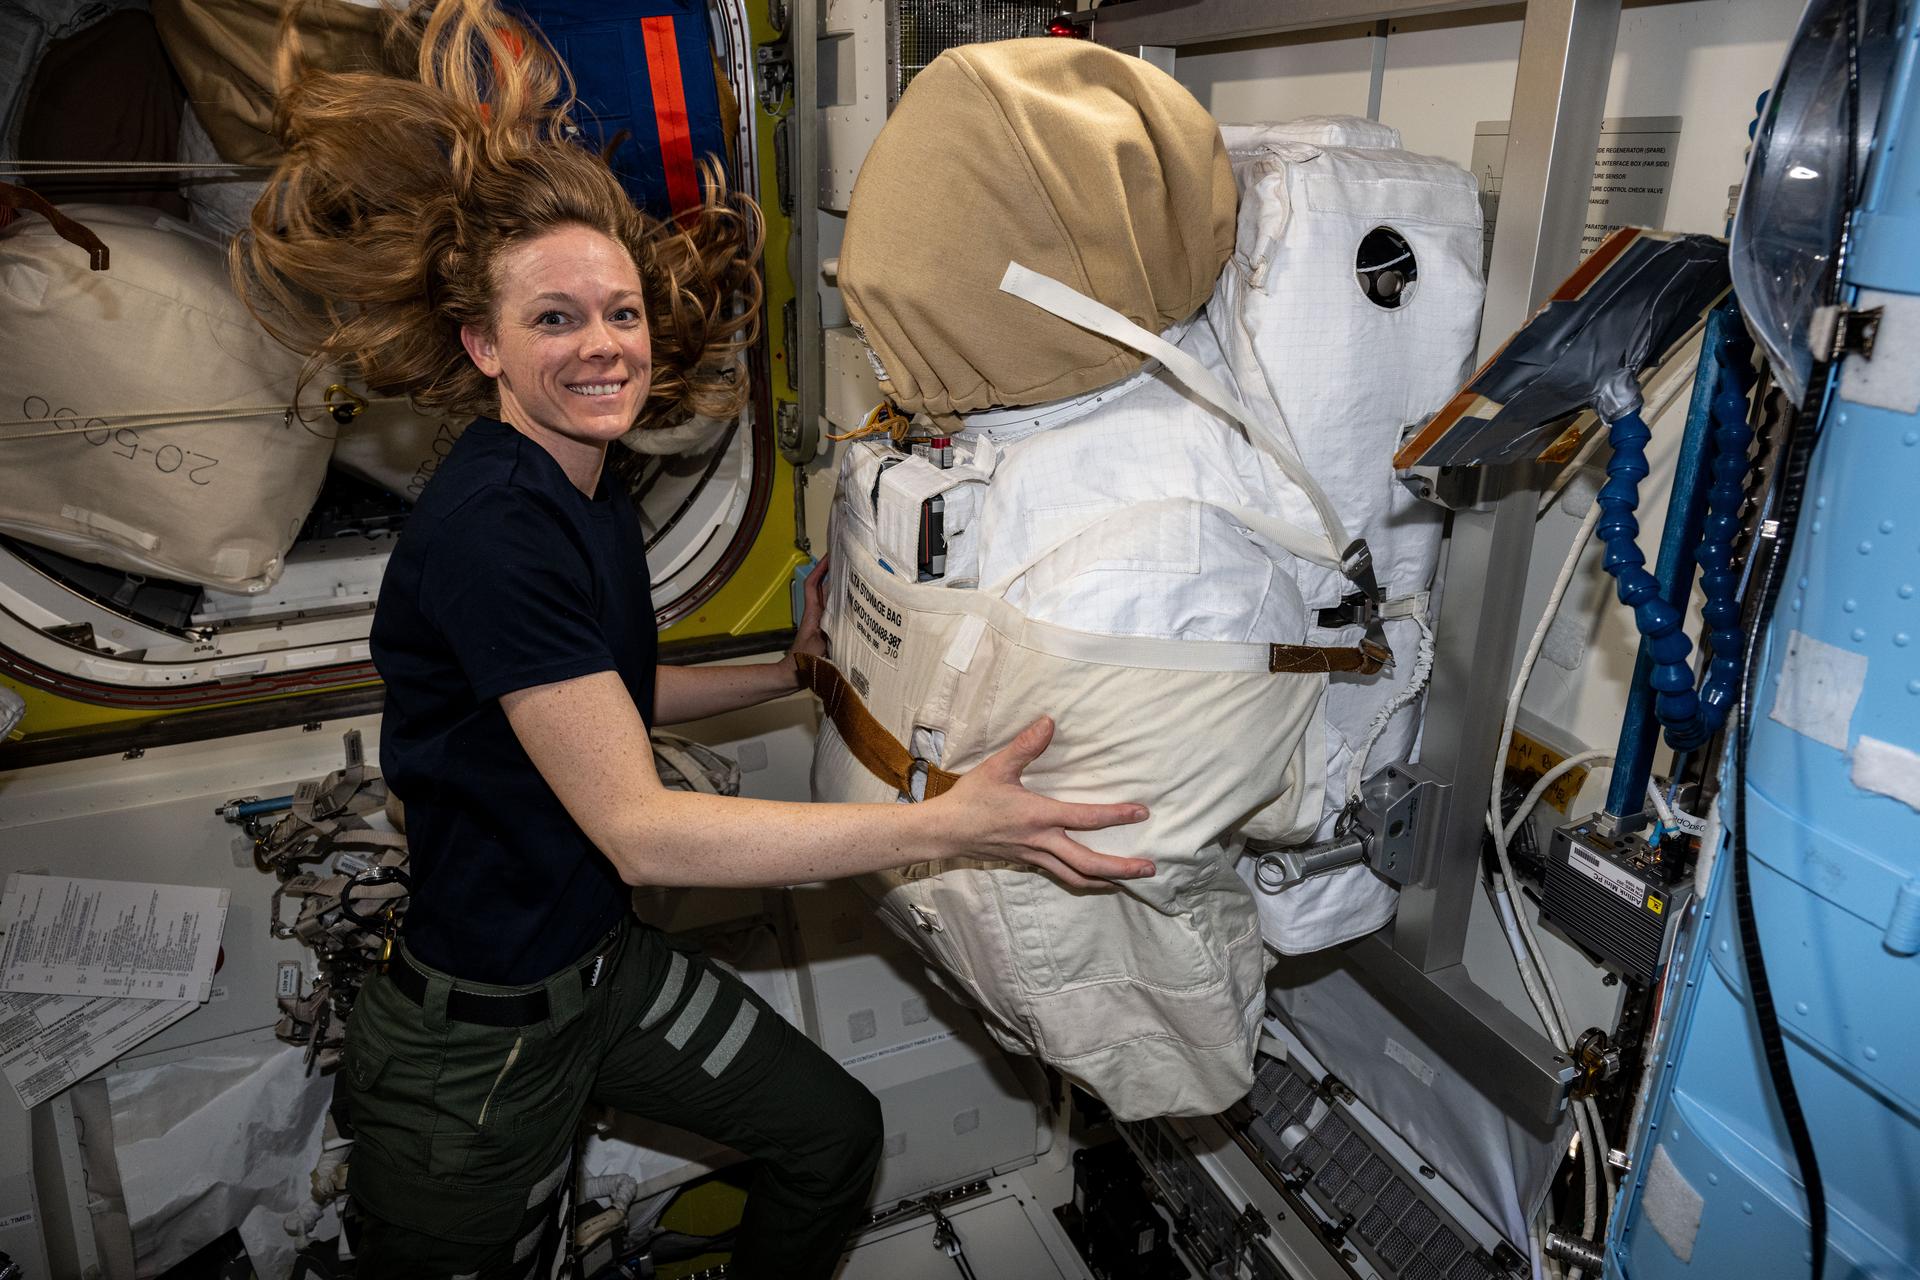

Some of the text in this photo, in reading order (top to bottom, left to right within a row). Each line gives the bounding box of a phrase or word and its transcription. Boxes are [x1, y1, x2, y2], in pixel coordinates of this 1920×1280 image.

[23, 395, 219, 486] 2.0-5090
[860, 583, 886, 618] STOWAGE
[886, 608, 902, 627] BAG
[884, 646, 898, 659] 310
[1593, 872, 1642, 906] Adlink Mini PC
[842, 1058, 857, 1067] AVOID
[856, 1052, 878, 1062] CONTACT
[10, 1214, 32, 1224] TIMES
